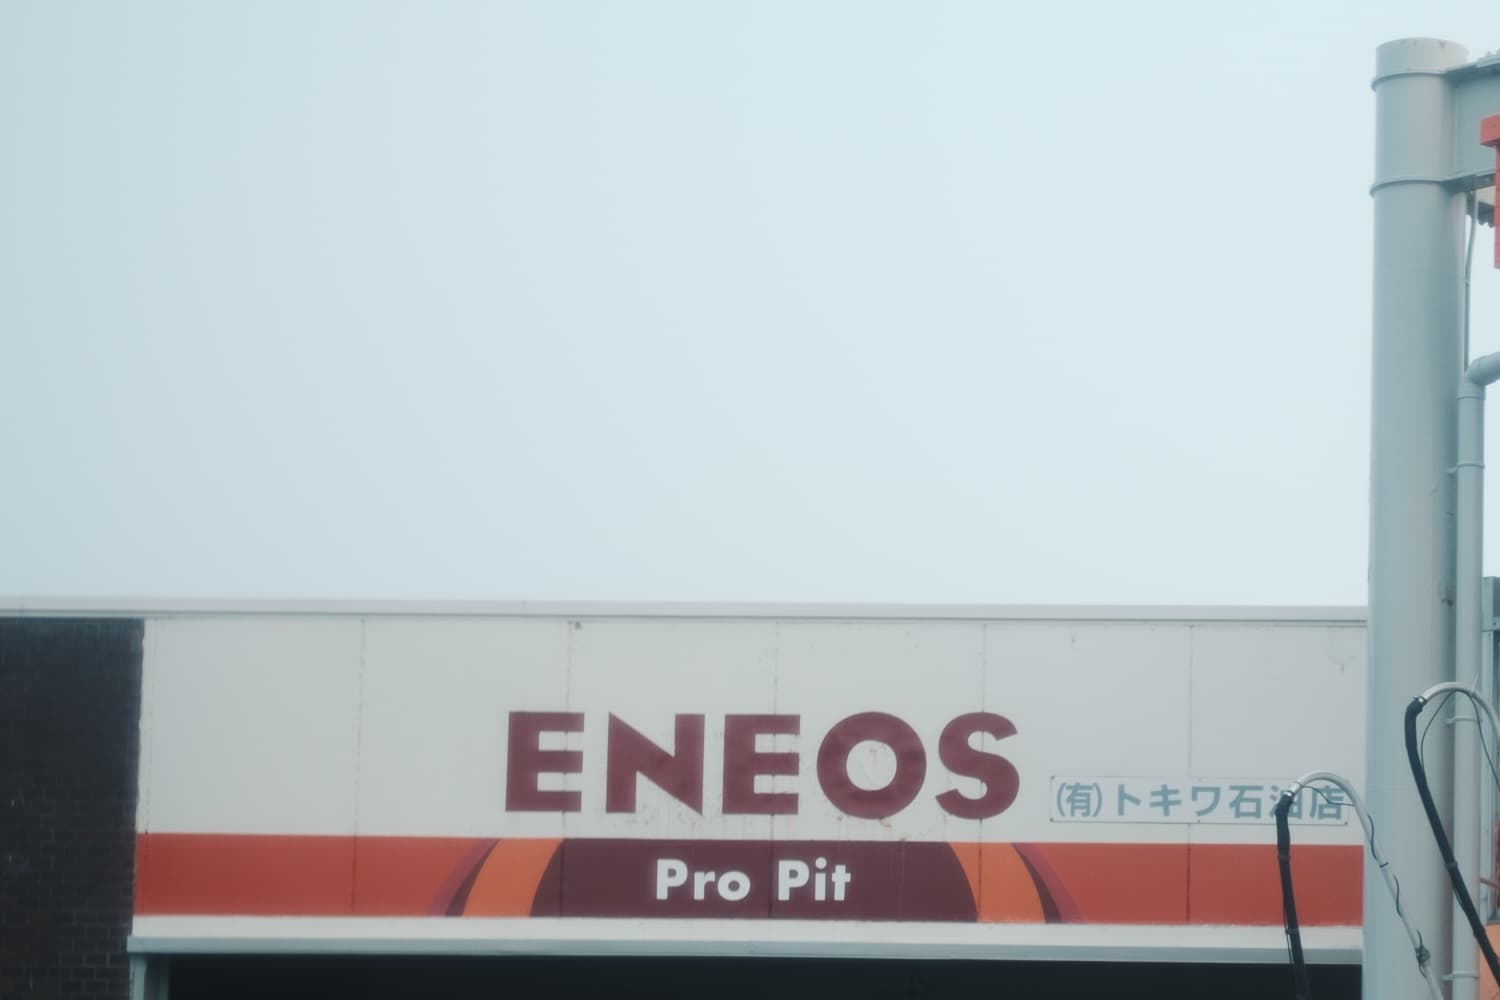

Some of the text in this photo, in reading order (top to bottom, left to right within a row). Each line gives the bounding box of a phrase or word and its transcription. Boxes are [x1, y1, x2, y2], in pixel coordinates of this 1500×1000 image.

[505, 711, 1020, 820] ENEOS
[655, 857, 853, 903] Pro Pit
